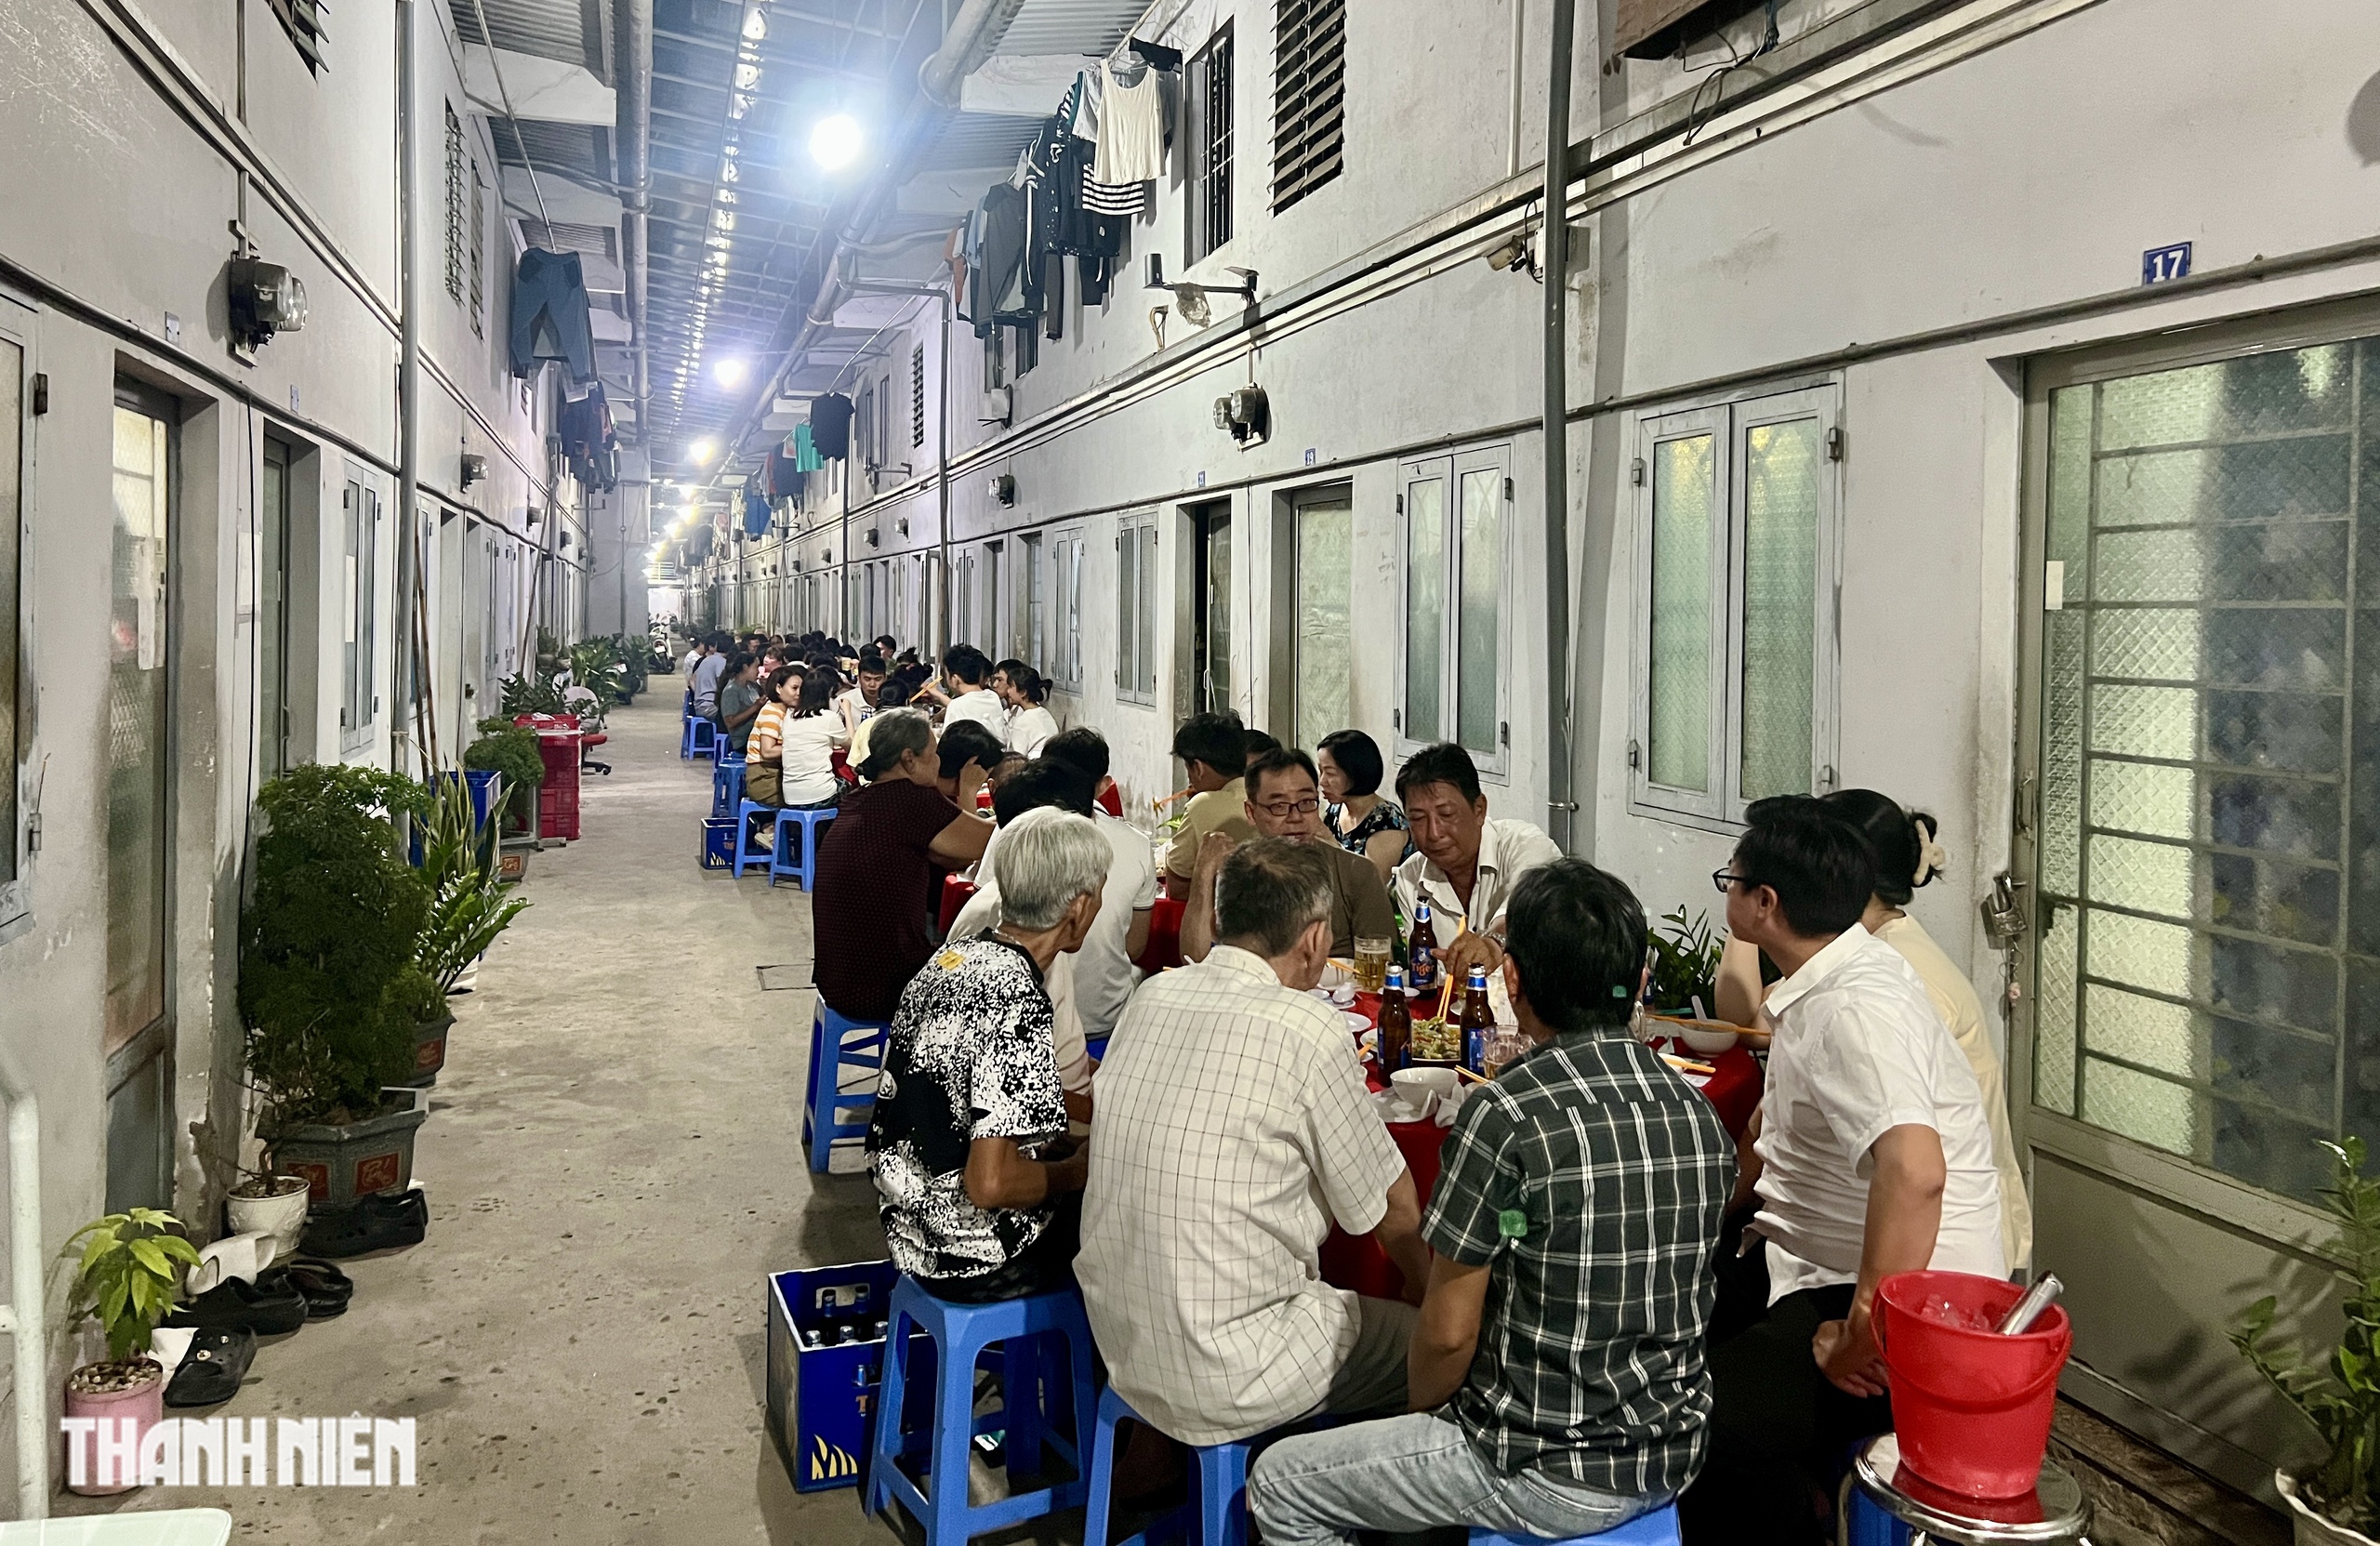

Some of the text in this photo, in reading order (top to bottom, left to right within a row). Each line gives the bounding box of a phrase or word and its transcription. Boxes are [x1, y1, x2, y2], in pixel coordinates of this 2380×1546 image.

[2152, 249, 2184, 283] 17
[1306, 451, 1314, 465] 19
[1411, 962, 1435, 976] Tiger
